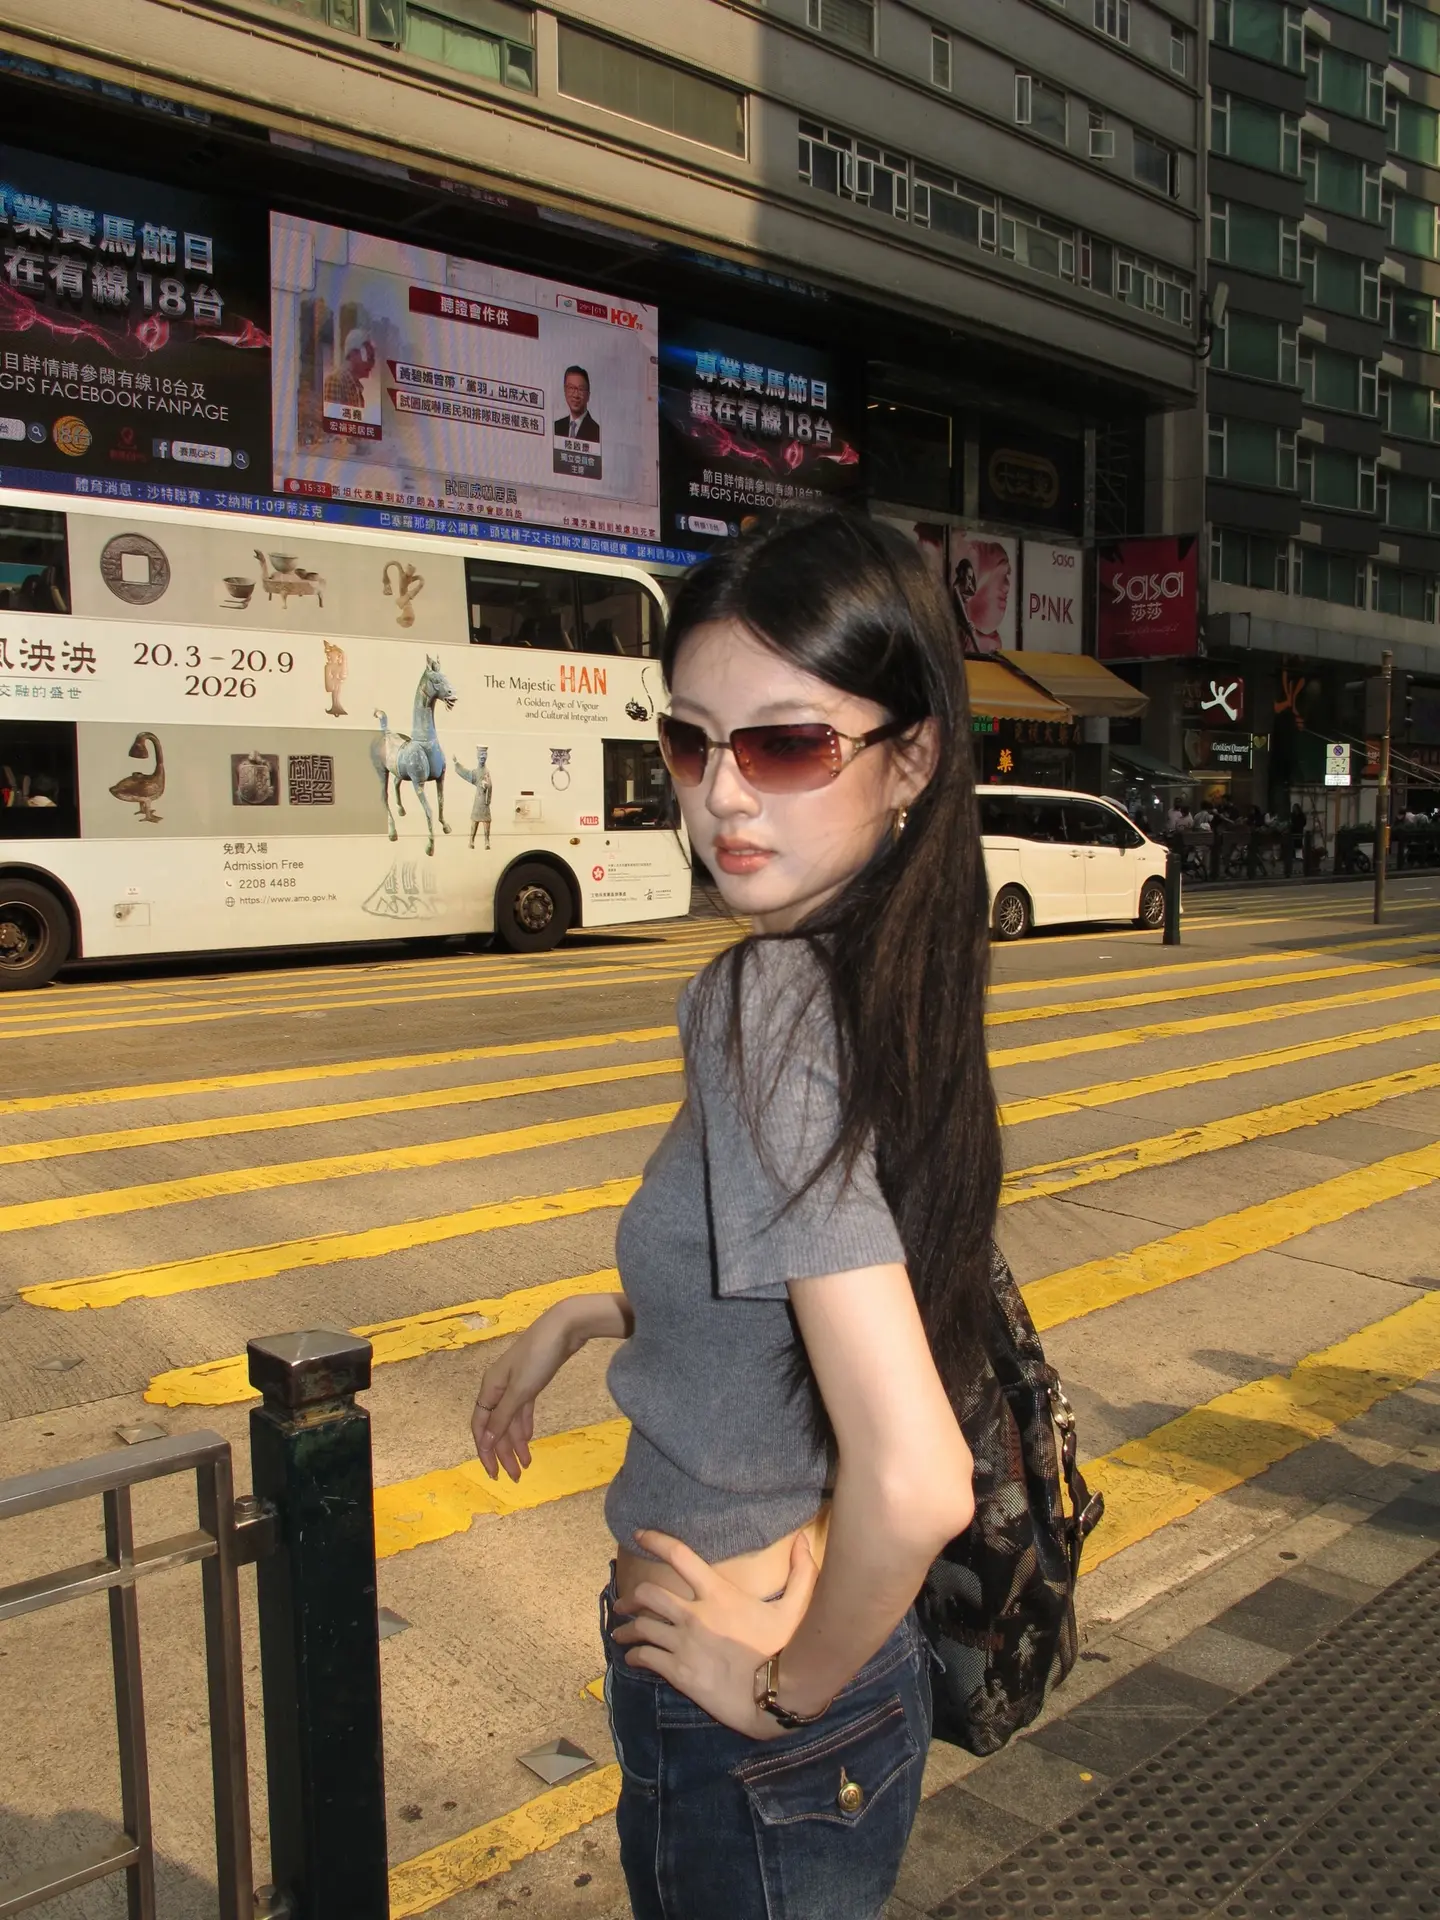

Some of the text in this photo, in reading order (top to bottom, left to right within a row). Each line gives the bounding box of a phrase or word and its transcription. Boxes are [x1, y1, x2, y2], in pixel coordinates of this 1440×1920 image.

[0, 187, 213, 274] 業賽馬節目
[4, 246, 224, 326] 在有線18台
[441, 296, 508, 326] 聽證會作供
[611, 308, 638, 328] HOY
[0, 352, 206, 400] 目詳情請參閱有線18台及
[696, 350, 827, 410] 專業賽馬節目
[0, 373, 229, 421] GPS FACEBOOK FANPAGE
[303, 483, 326, 494] 15:33
[1029, 593, 1074, 625] P!NK
[1131, 602, 1163, 622] 莎莎
[185, 675, 257, 698] 2026
[484, 665, 607, 696] The Majestic HAN
[0, 684, 83, 700] 交融的盛世
[516, 697, 599, 712] A Golden Age of Vigour
[525, 710, 608, 723] and Cultural Integration
[580, 816, 599, 826] KMB
[223, 842, 268, 855] 免費入場
[223, 859, 304, 871] Admission Free
[239, 877, 296, 889] 2208 4488
[239, 893, 337, 905] https://www.amo.gov.hk
